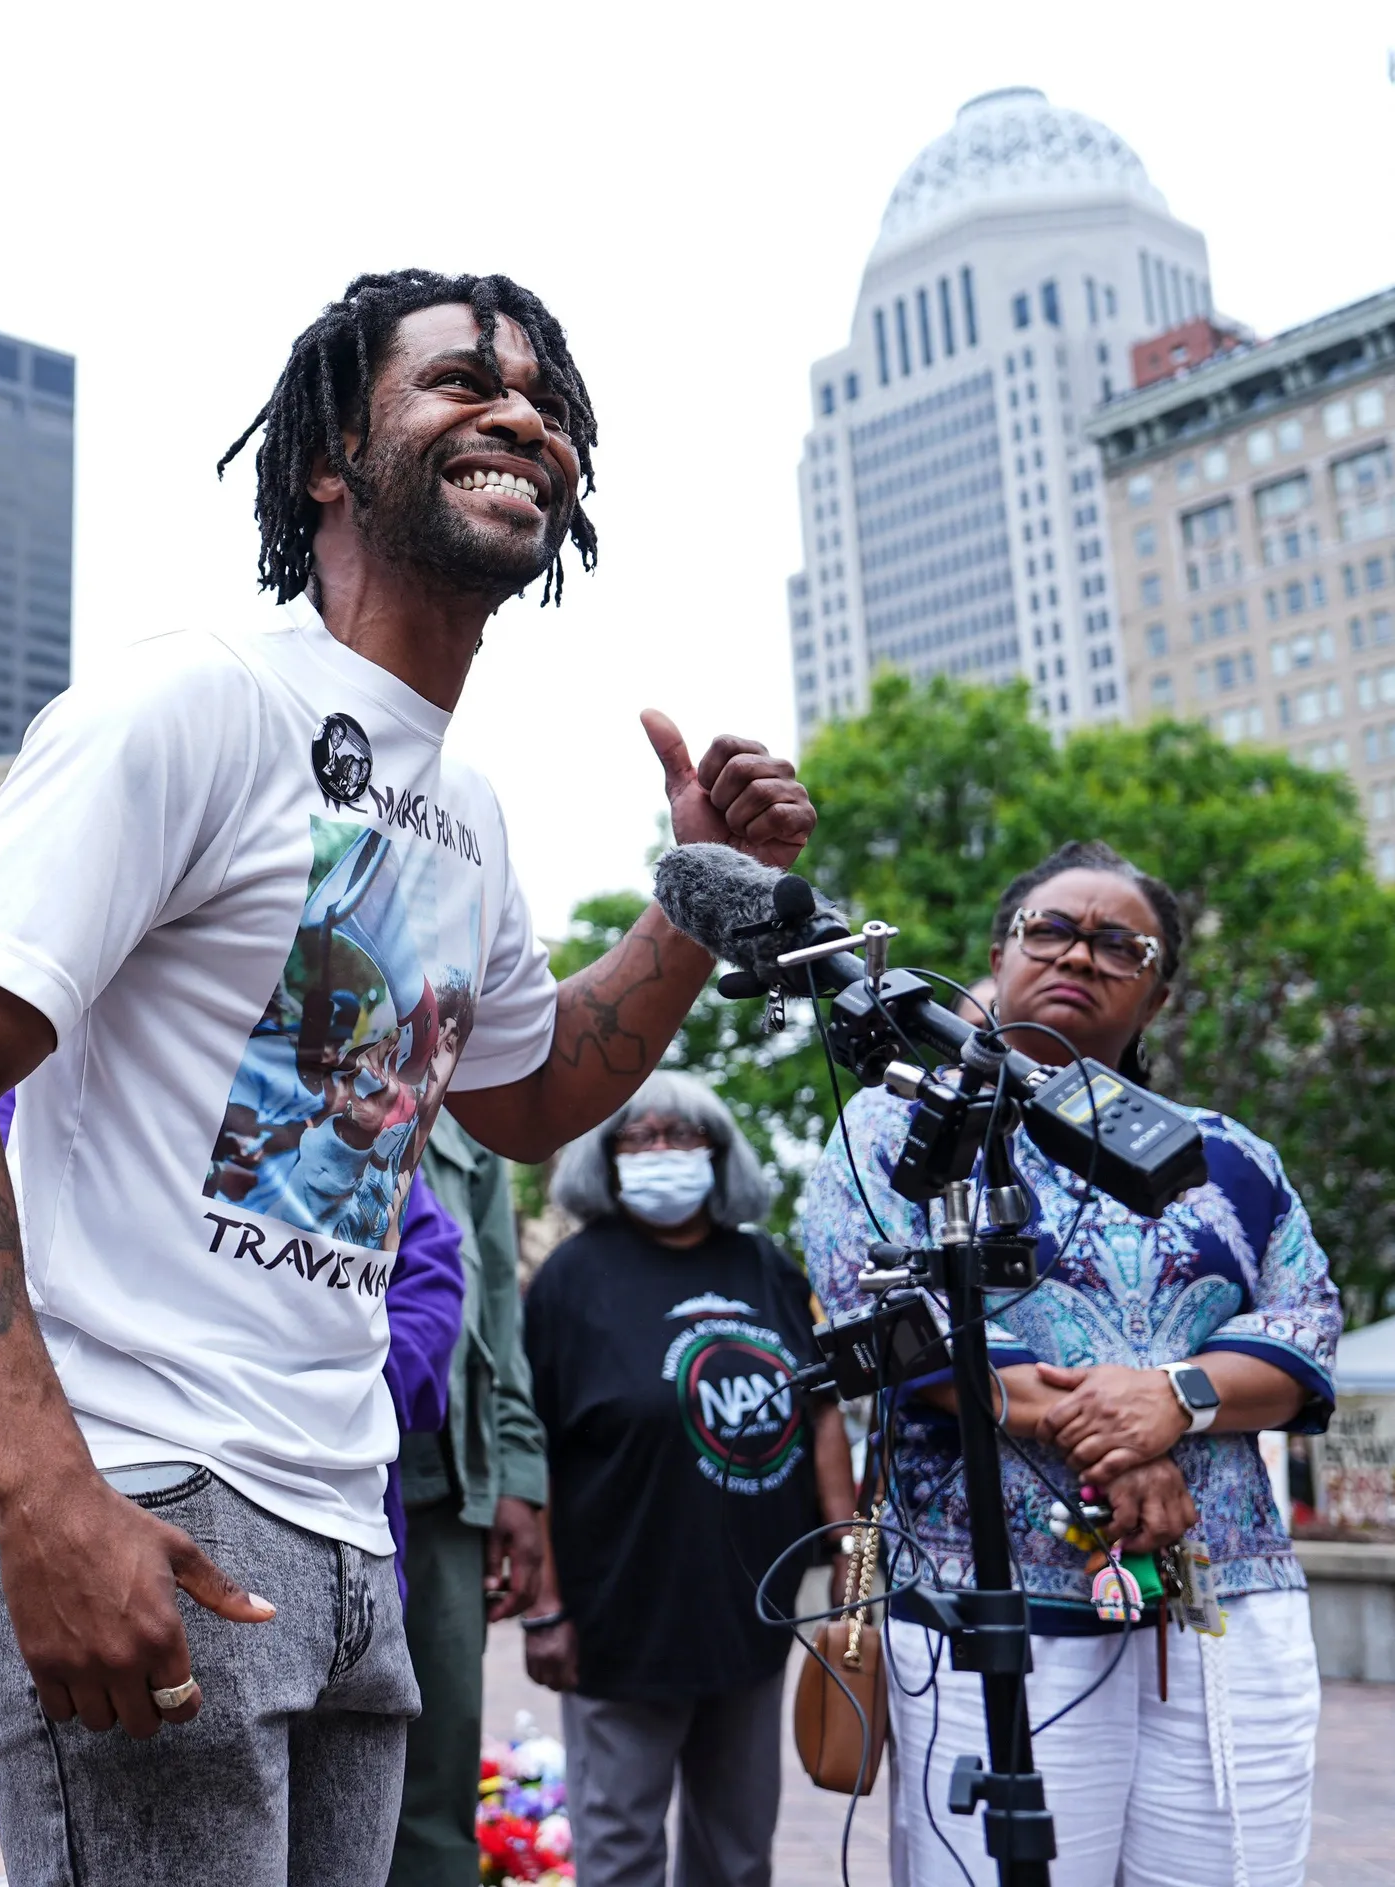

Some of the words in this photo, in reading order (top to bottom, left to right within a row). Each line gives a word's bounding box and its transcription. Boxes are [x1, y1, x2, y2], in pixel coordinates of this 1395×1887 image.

[368, 785, 432, 841] MARCH
[434, 803, 456, 853] FOR
[456, 819, 482, 867] YOU
[1129, 1120, 1168, 1150] SONY
[203, 1211, 356, 1290] TRAVIS
[697, 1370, 793, 1431] NAN
